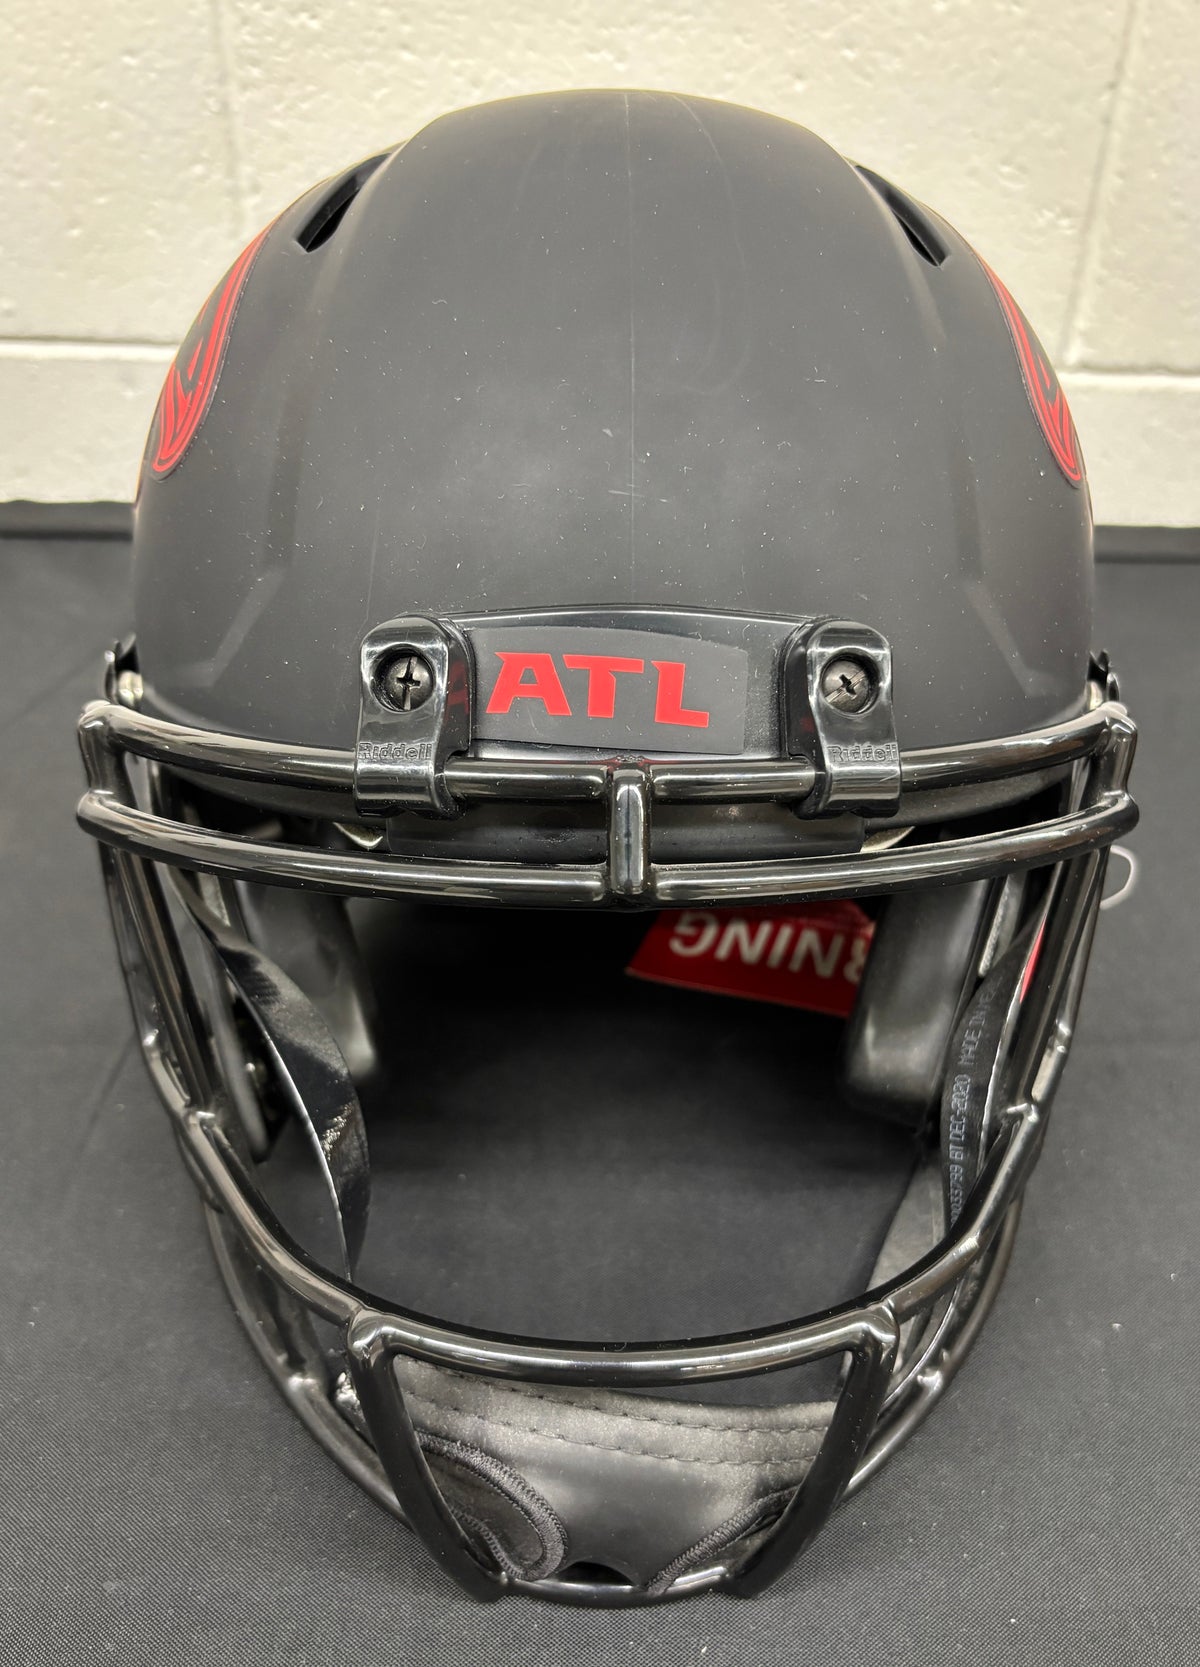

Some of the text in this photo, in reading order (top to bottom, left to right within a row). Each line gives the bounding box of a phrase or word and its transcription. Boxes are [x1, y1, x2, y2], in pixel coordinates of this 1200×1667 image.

[486, 651, 709, 728] ATL
[358, 742, 432, 760] Riddell
[827, 743, 898, 762] Riddell
[957, 1028, 982, 1065] MADE
